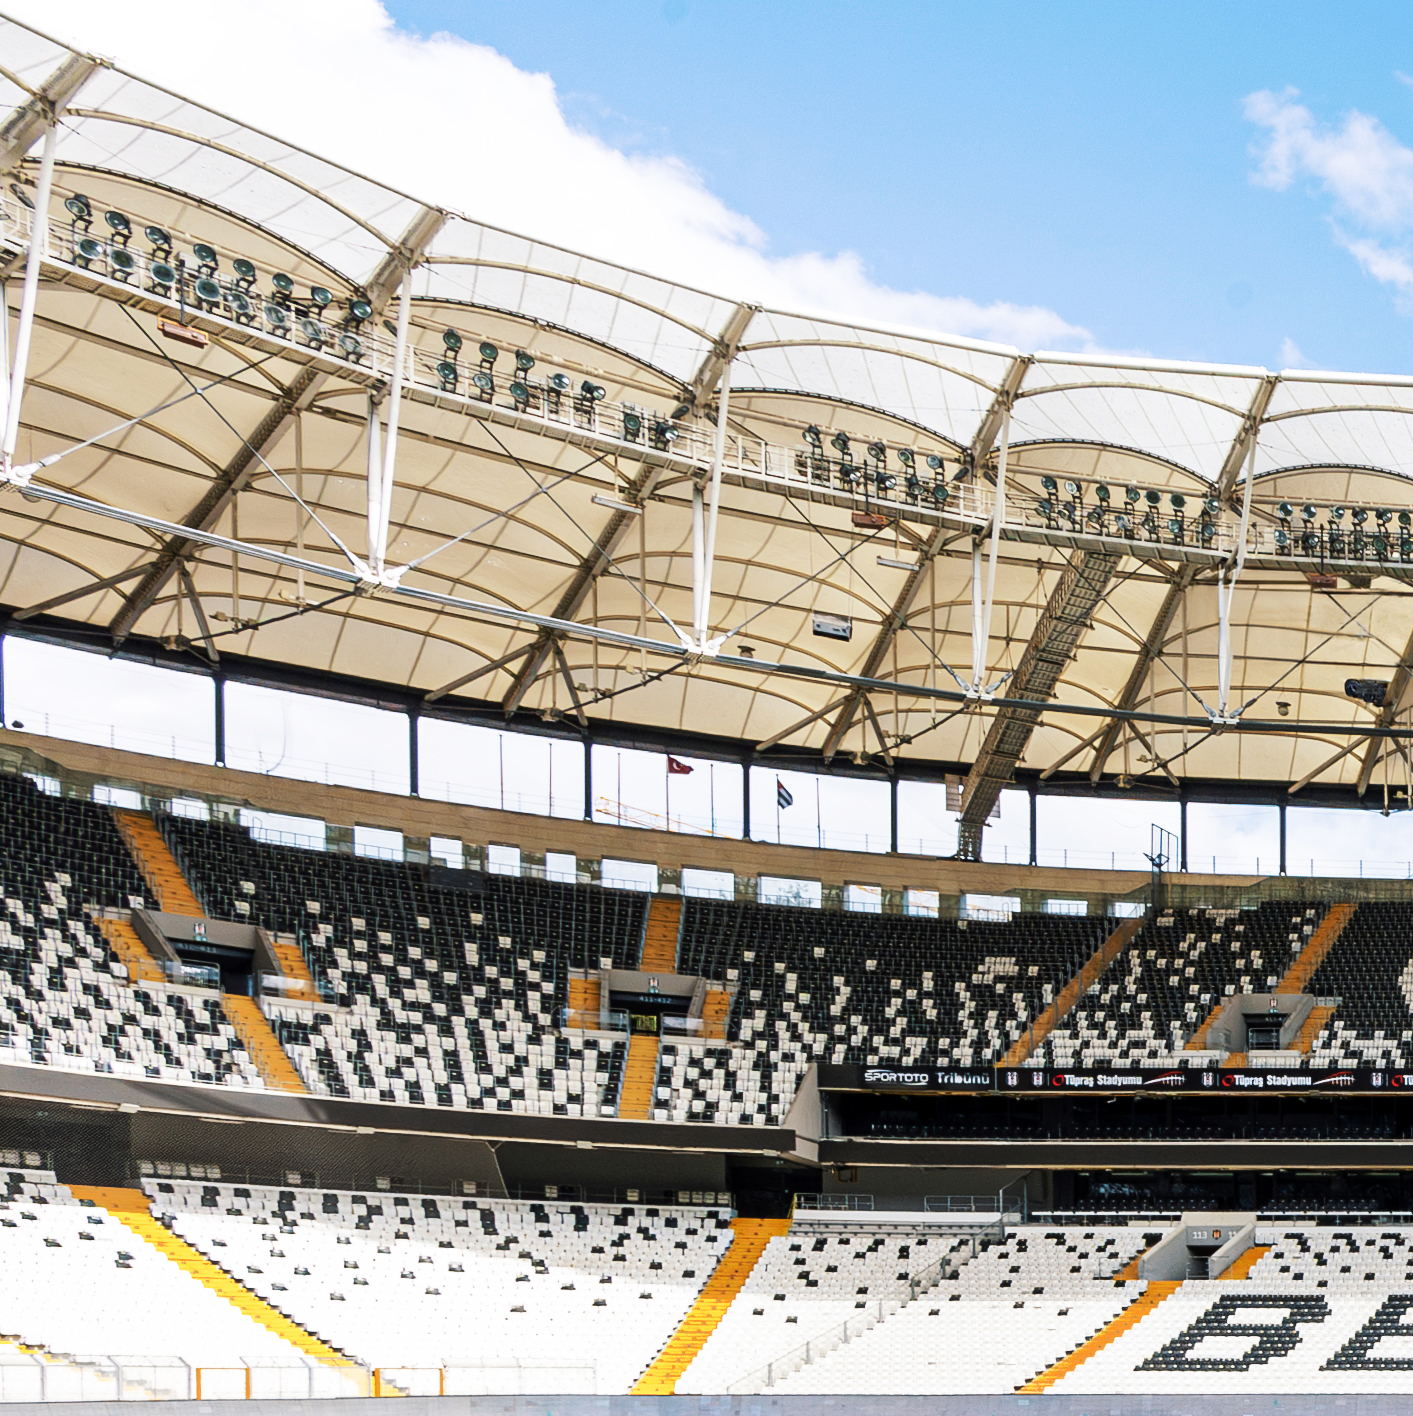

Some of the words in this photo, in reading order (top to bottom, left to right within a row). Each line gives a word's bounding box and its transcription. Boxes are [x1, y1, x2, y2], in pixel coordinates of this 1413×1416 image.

[935, 1071, 990, 1084] Tribünü
[1064, 1074, 1094, 1088] Tüpraş
[1097, 1075, 1143, 1087] Stadyumu
[1234, 1075, 1264, 1088] Tüpraş
[1267, 1076, 1311, 1087] Stadyumu
